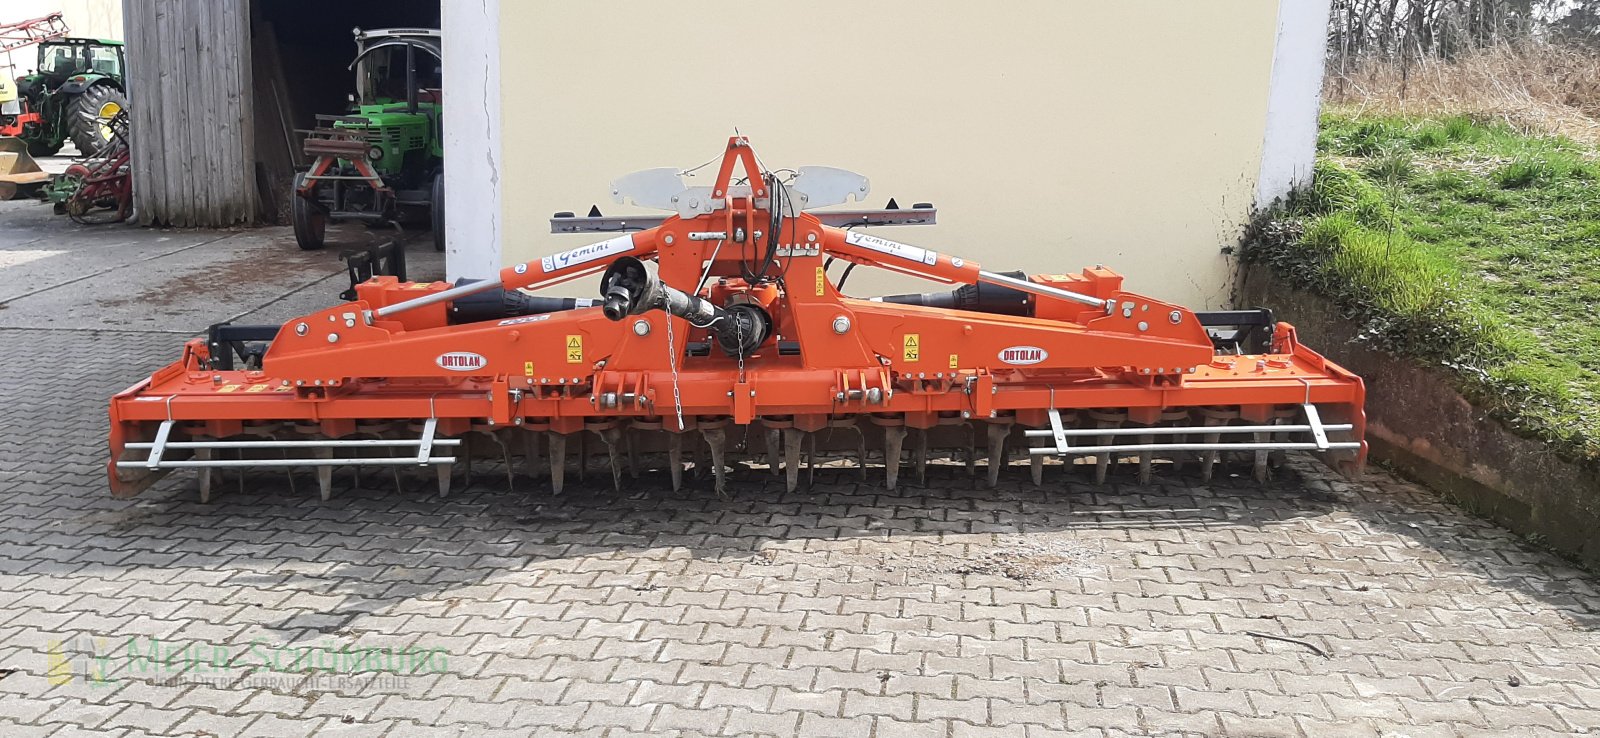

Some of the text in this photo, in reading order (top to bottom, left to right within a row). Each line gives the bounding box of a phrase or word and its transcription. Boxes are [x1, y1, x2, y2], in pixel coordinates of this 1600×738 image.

[853, 232, 902, 250] Gemini
[559, 240, 609, 265] Gemini
[441, 355, 481, 367] ORTOLAN
[1003, 350, 1041, 361] ORTOLAN
